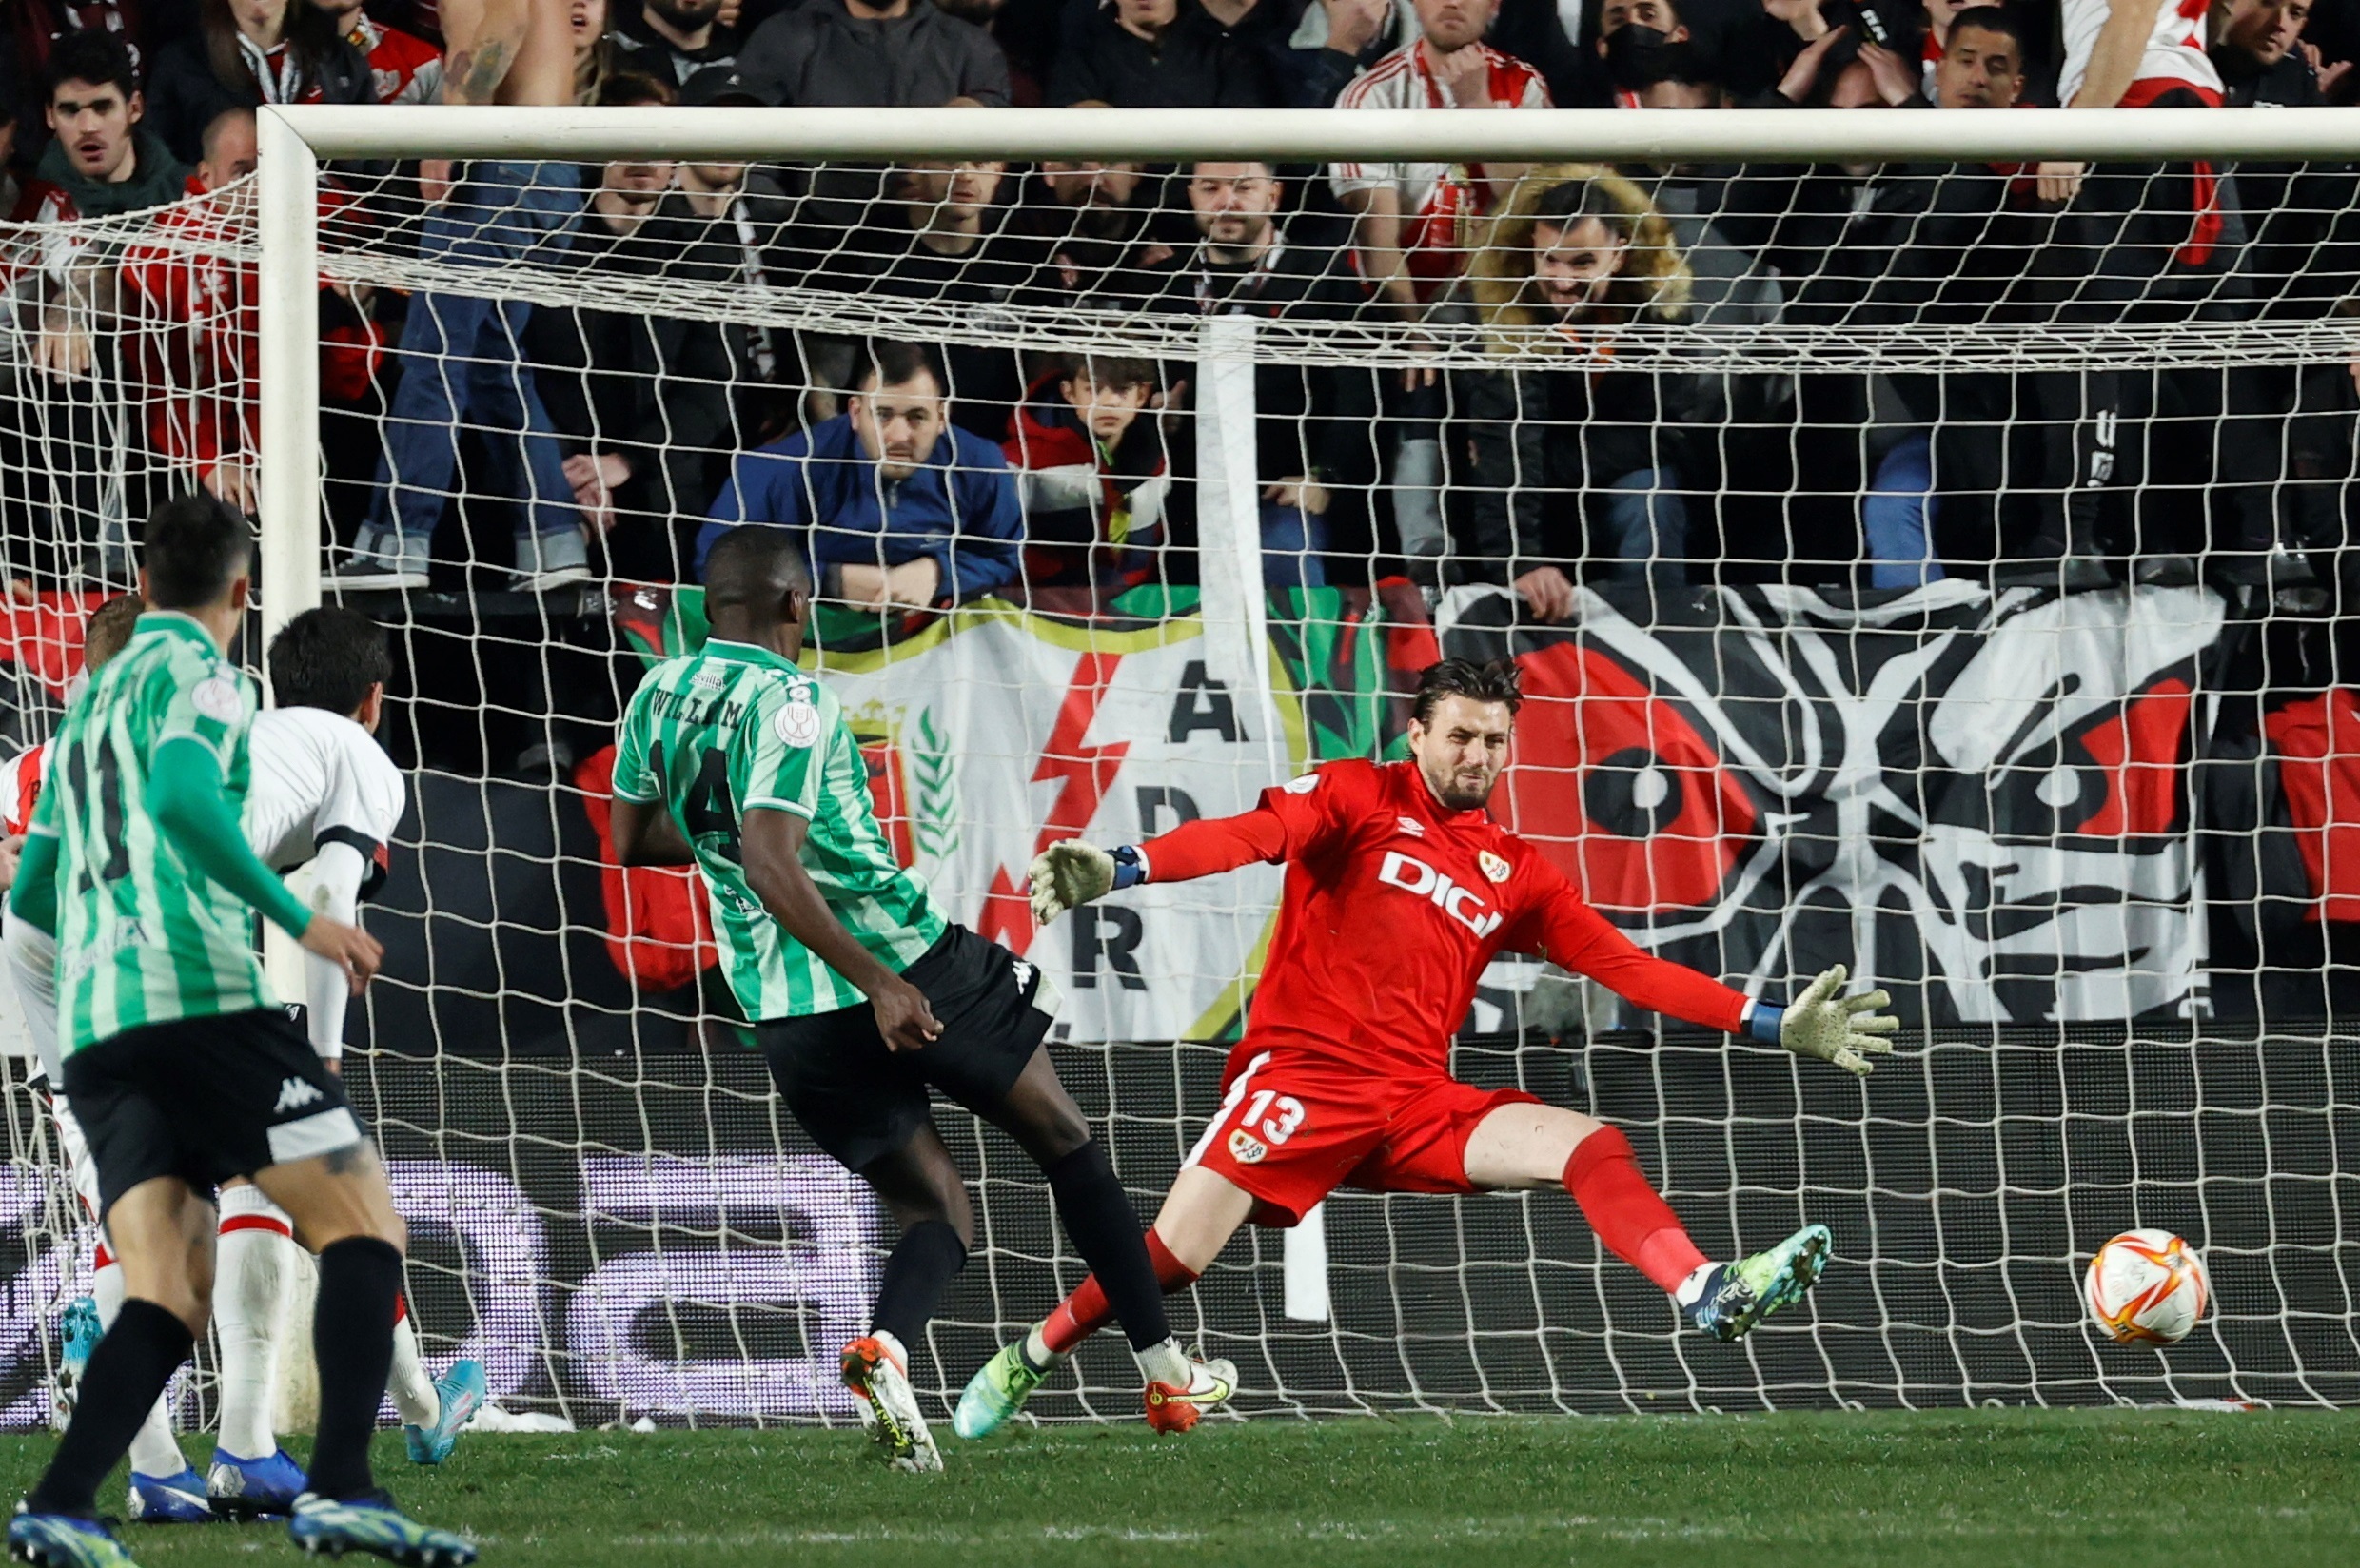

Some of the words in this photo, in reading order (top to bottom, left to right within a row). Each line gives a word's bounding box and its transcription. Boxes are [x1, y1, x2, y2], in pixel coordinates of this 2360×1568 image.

[68, 731, 131, 896] 11
[1378, 850, 1504, 940] DIGI
[1240, 1089, 1306, 1146] 13
